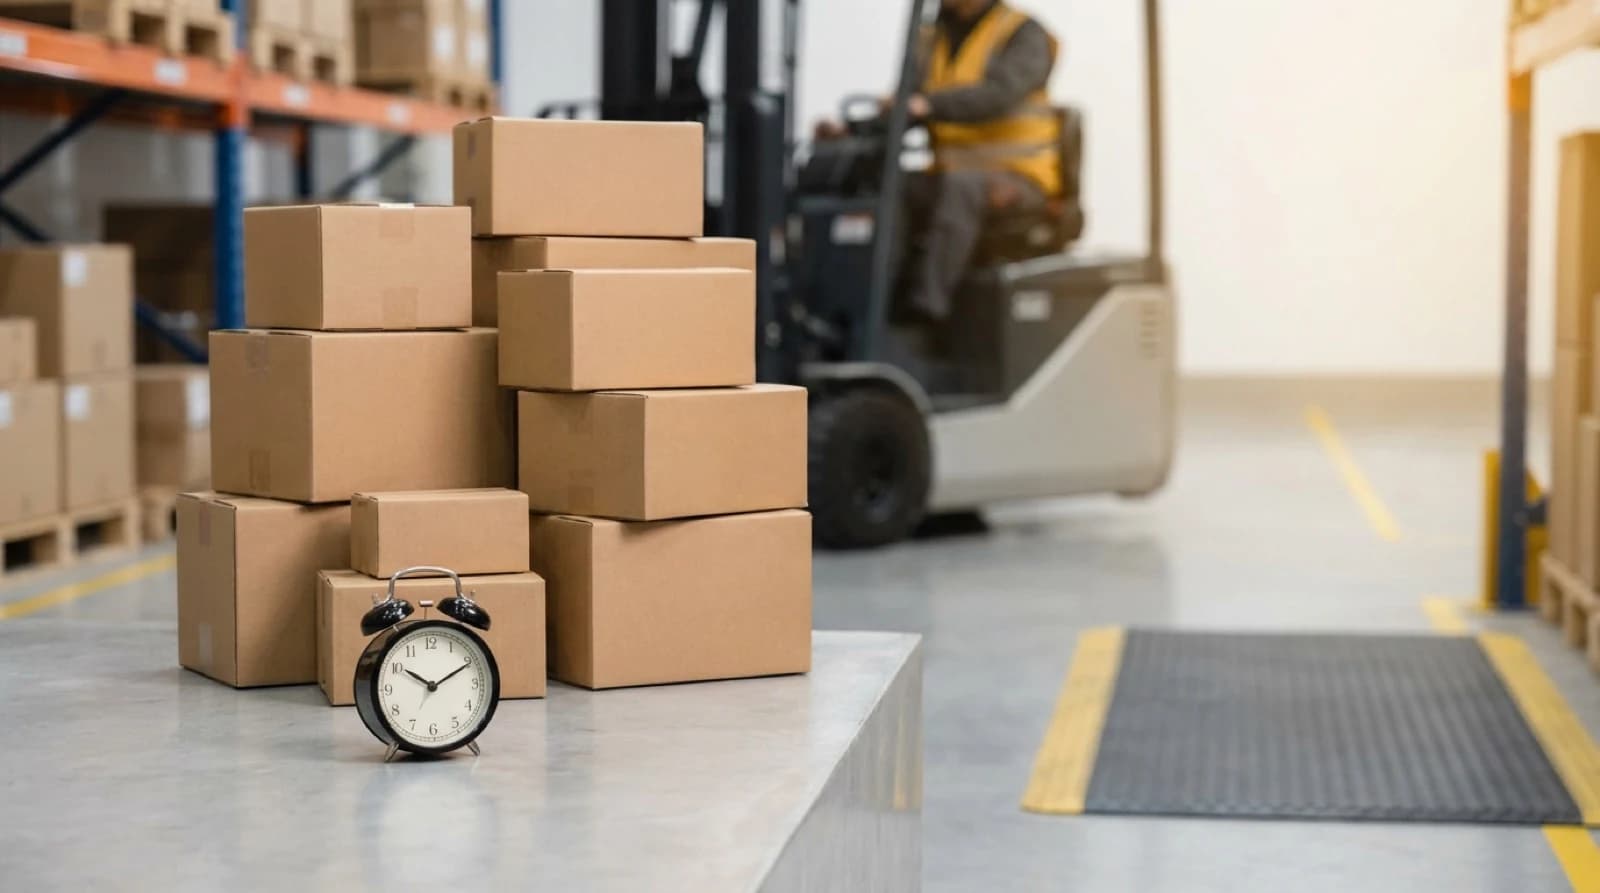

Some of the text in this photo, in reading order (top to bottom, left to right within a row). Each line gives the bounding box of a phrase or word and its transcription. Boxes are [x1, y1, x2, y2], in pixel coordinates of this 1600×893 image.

[426, 637, 437, 649] 12
[406, 645, 415, 657] 11
[392, 662, 403, 674] 10
[385, 684, 392, 696] 9
[392, 704, 399, 716] 8
[464, 699, 471, 711] 4
[409, 719, 416, 730] 7
[451, 716, 459, 729] 5
[429, 723, 438, 735] 6
